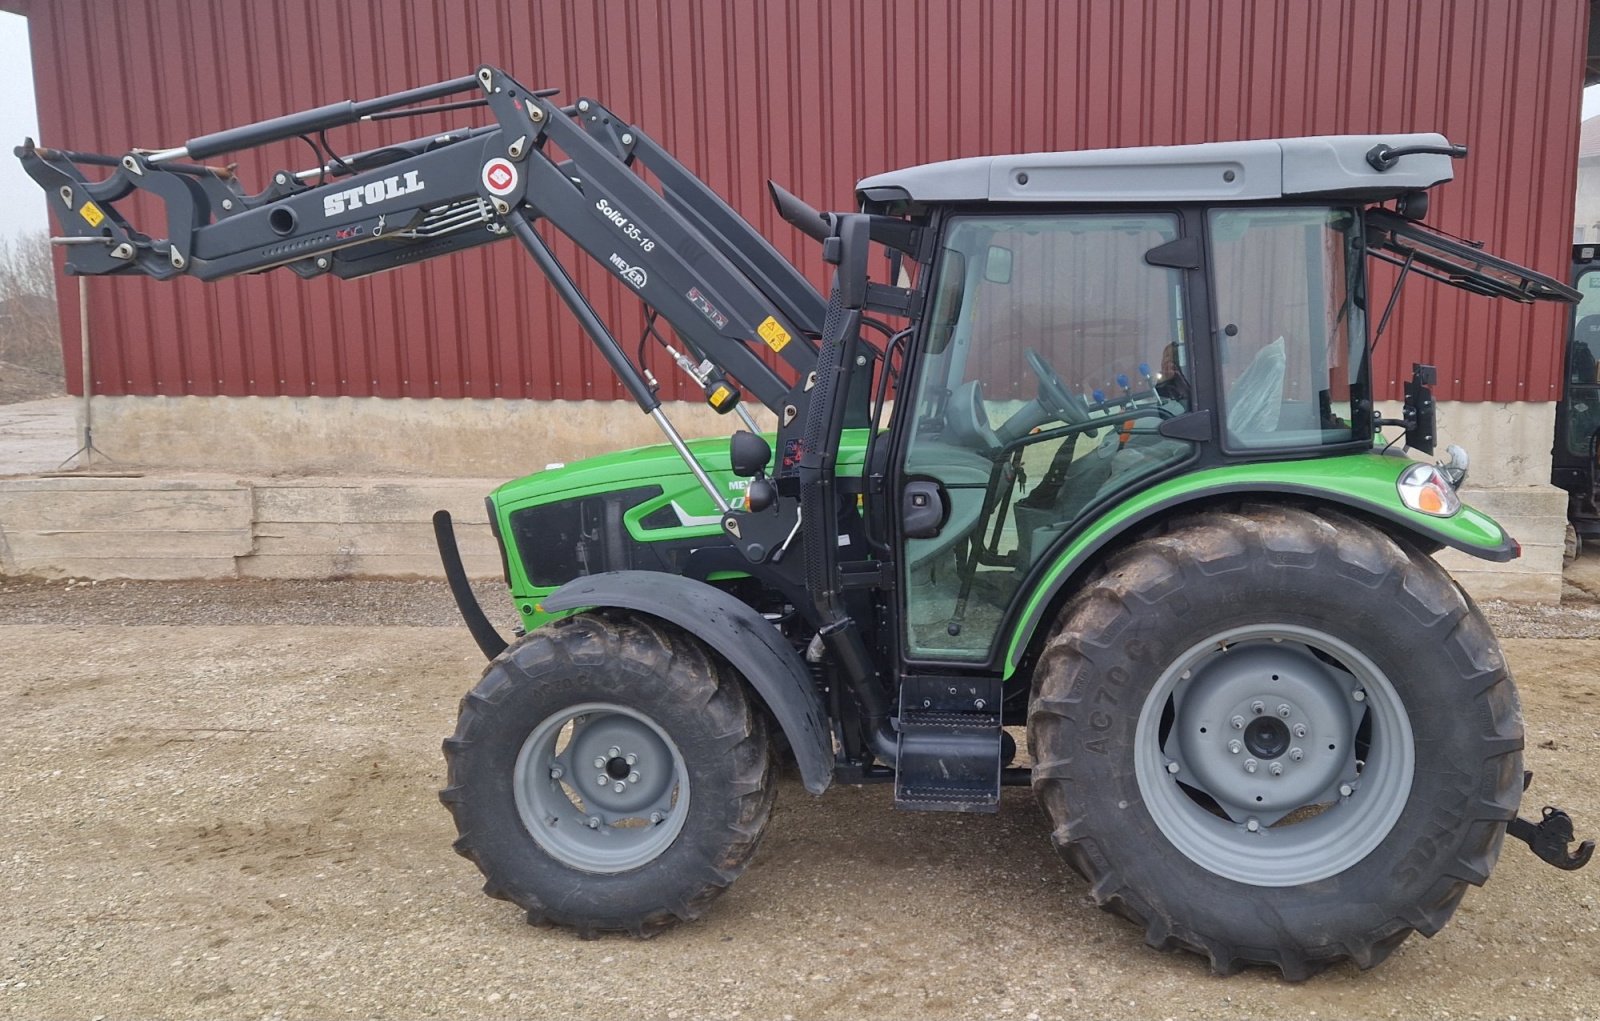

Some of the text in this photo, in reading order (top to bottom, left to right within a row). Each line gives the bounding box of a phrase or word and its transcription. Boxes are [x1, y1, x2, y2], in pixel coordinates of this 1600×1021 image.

[323, 170, 425, 217] STOLL
[596, 199, 655, 252] Solid 35-18
[609, 252, 646, 287] MEYER
